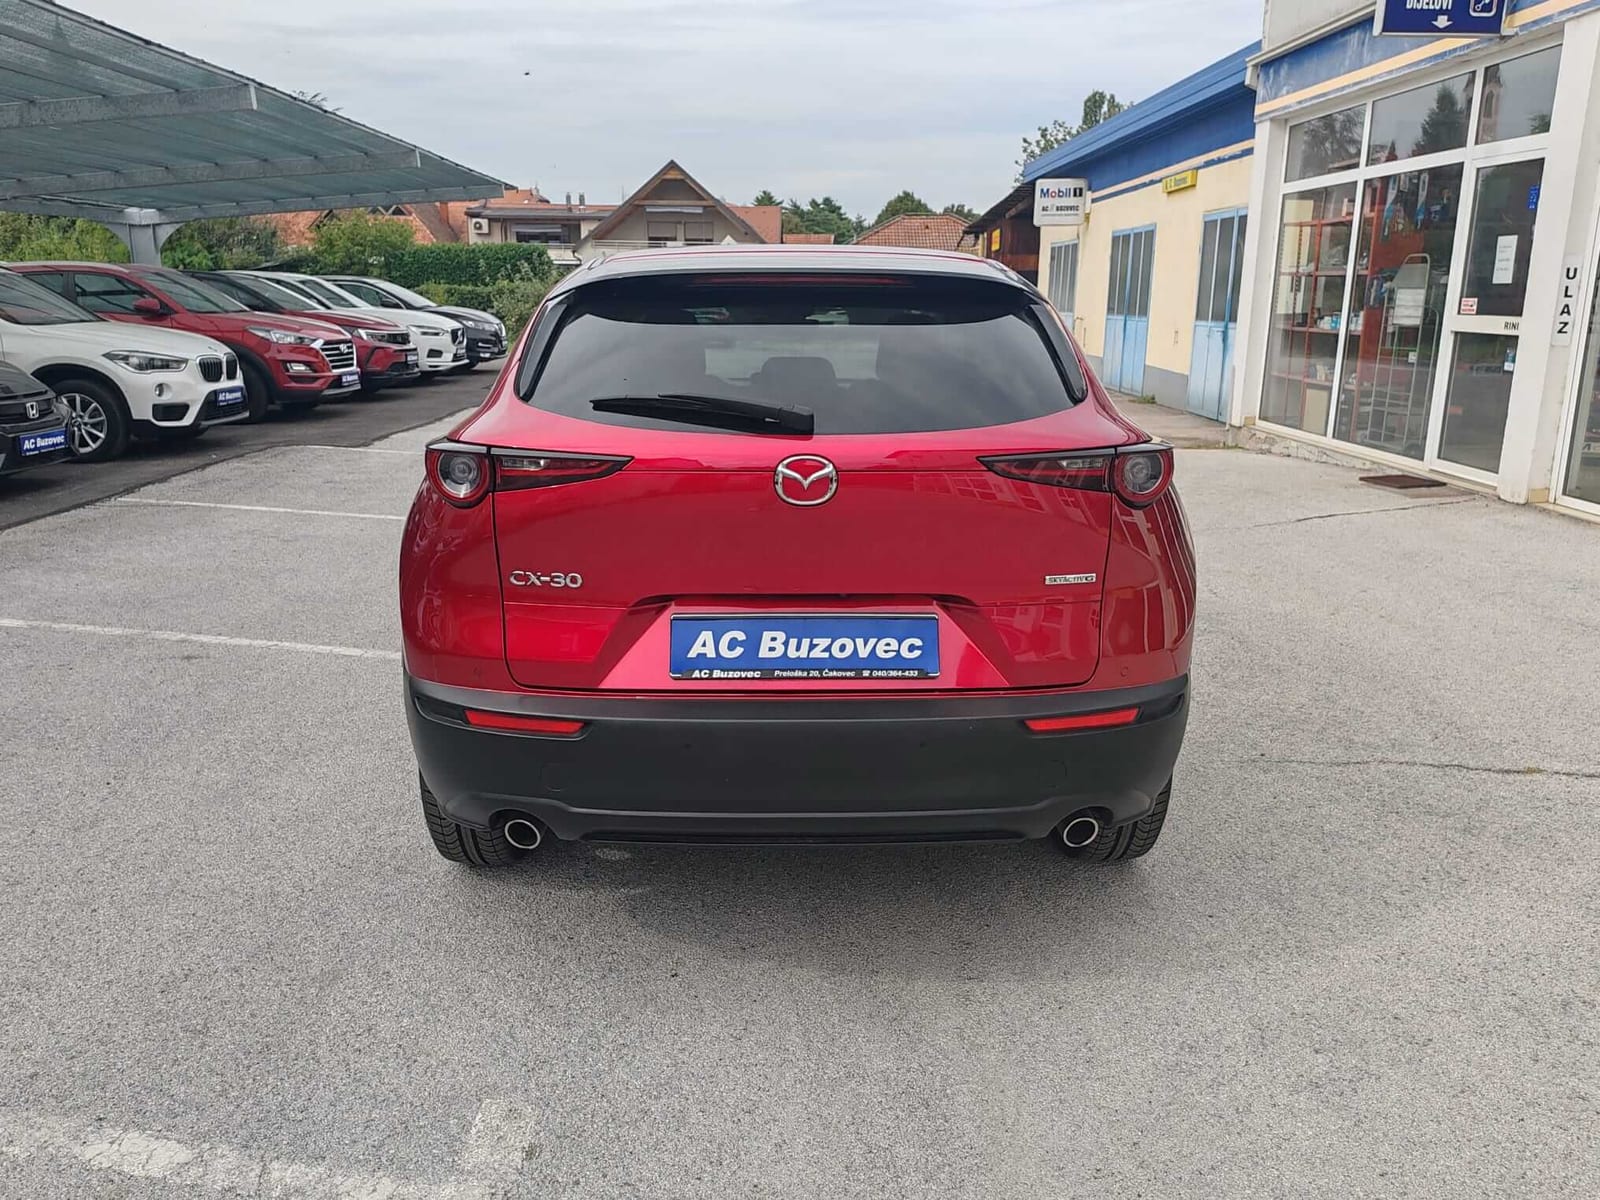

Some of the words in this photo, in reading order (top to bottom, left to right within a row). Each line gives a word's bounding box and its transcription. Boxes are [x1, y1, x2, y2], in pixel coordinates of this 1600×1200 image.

[1040, 188, 1071, 198] Mobil
[1557, 267, 1578, 334] ULAZ
[23, 438, 35, 450] AC
[36, 435, 65, 448] Buzovec
[509, 570, 583, 588] CX-30
[687, 630, 747, 659] AC
[758, 630, 923, 659] Buzovec
[692, 669, 710, 678] AC
[712, 669, 761, 678] Buzovec
[822, 668, 856, 677] Čakovec
